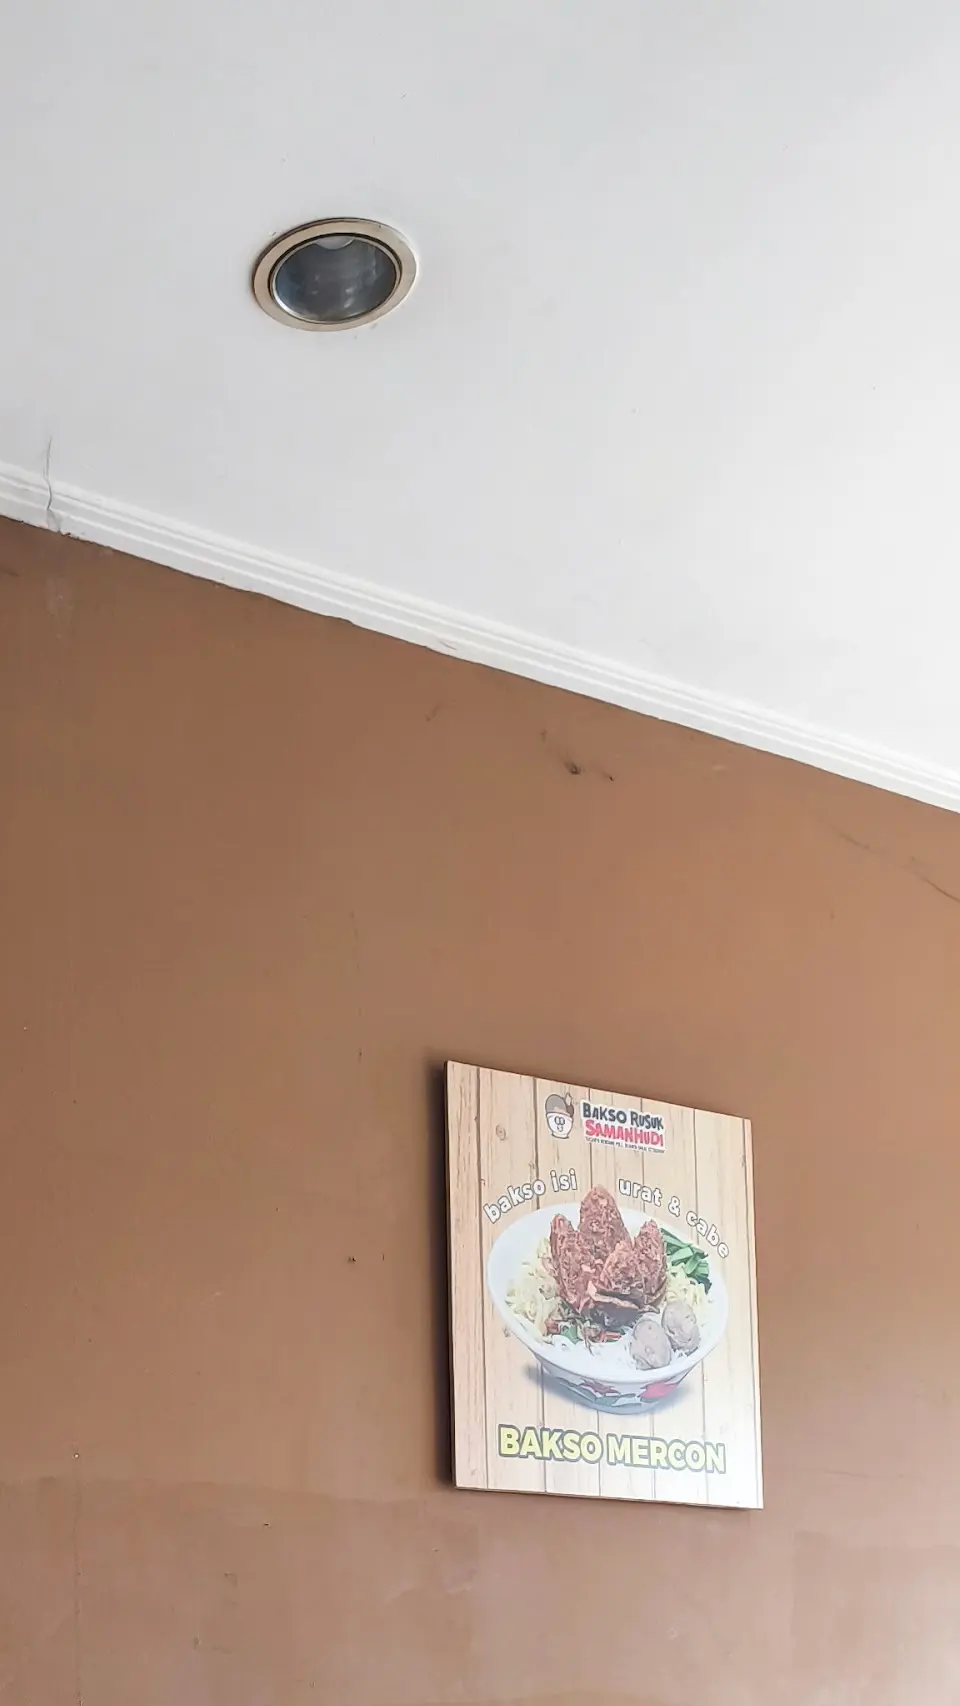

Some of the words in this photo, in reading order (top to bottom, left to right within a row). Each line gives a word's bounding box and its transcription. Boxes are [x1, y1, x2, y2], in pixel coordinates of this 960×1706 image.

[583, 1102, 627, 1124] BAKSO
[630, 1111, 664, 1131] RUSUK
[585, 1119, 664, 1147] SAMANHUDI
[483, 1178, 547, 1224] bakso
[549, 1168, 578, 1192] isi
[619, 1178, 663, 1207] urat
[668, 1196, 681, 1217] &
[685, 1211, 730, 1259] cabe
[498, 1424, 604, 1465] BAKSO
[606, 1432, 727, 1474] MERCON
